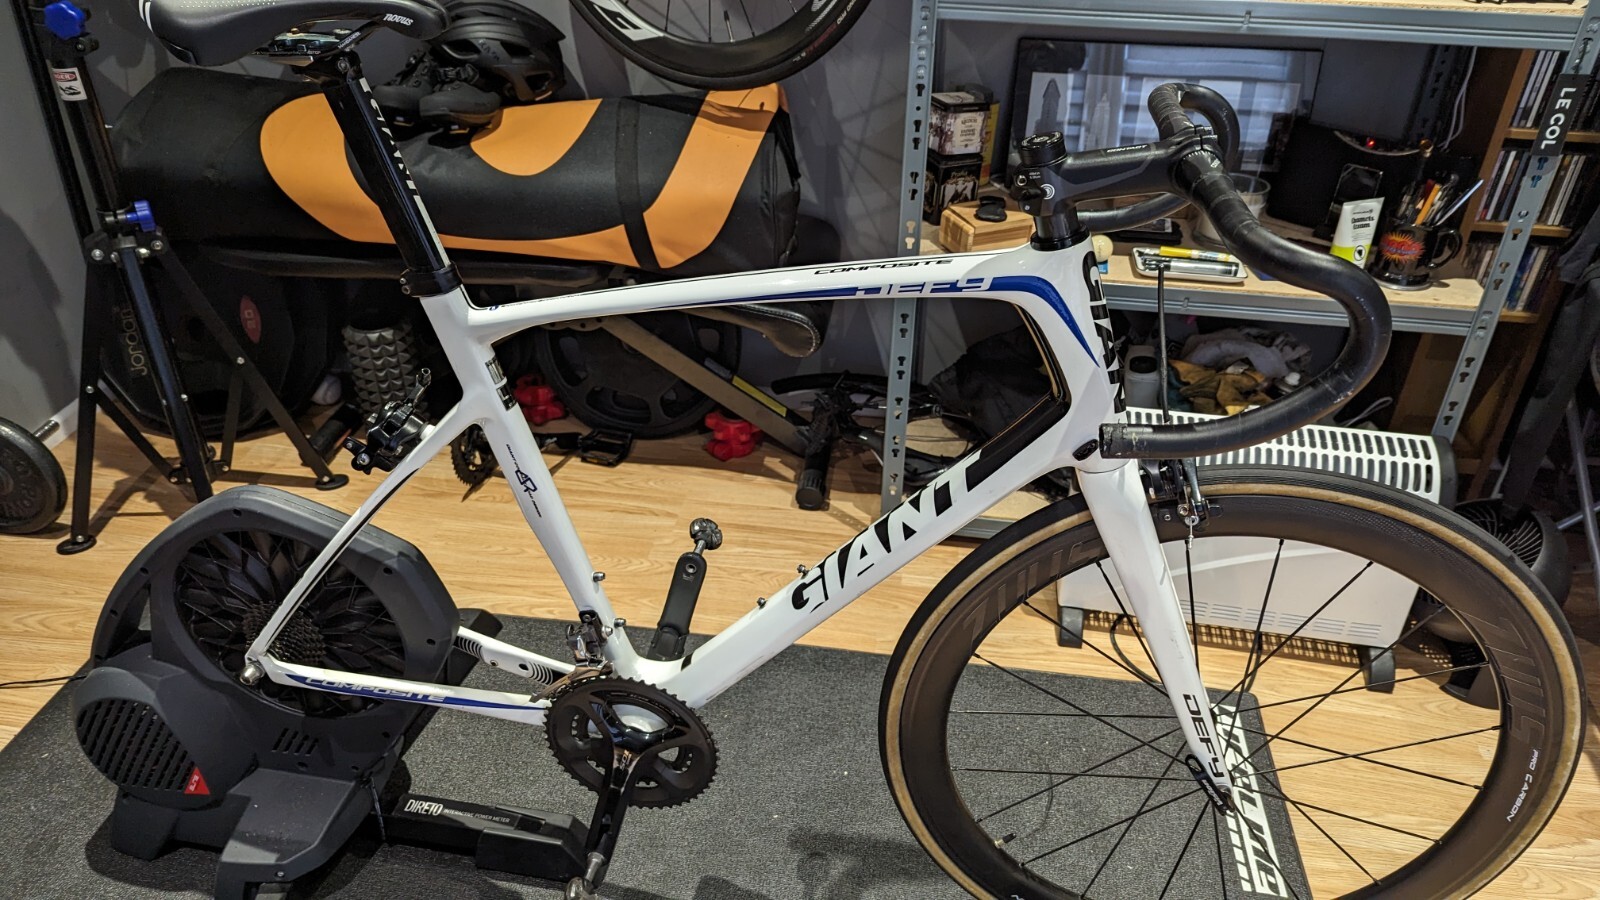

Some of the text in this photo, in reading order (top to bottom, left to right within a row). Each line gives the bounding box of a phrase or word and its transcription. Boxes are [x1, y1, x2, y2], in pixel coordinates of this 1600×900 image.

[1540, 87, 1577, 150] LE COL
[814, 259, 954, 275] COMPOSITE
[790, 446, 987, 614] GIANT
[305, 676, 446, 702] COMPOSITE
[1183, 694, 1225, 778] DEFY
[404, 799, 444, 816] DIRETO
[443, 808, 474, 818] INTERACTIVE
[475, 812, 493, 820] POWER
[1506, 749, 1539, 822] PRO CARBON
